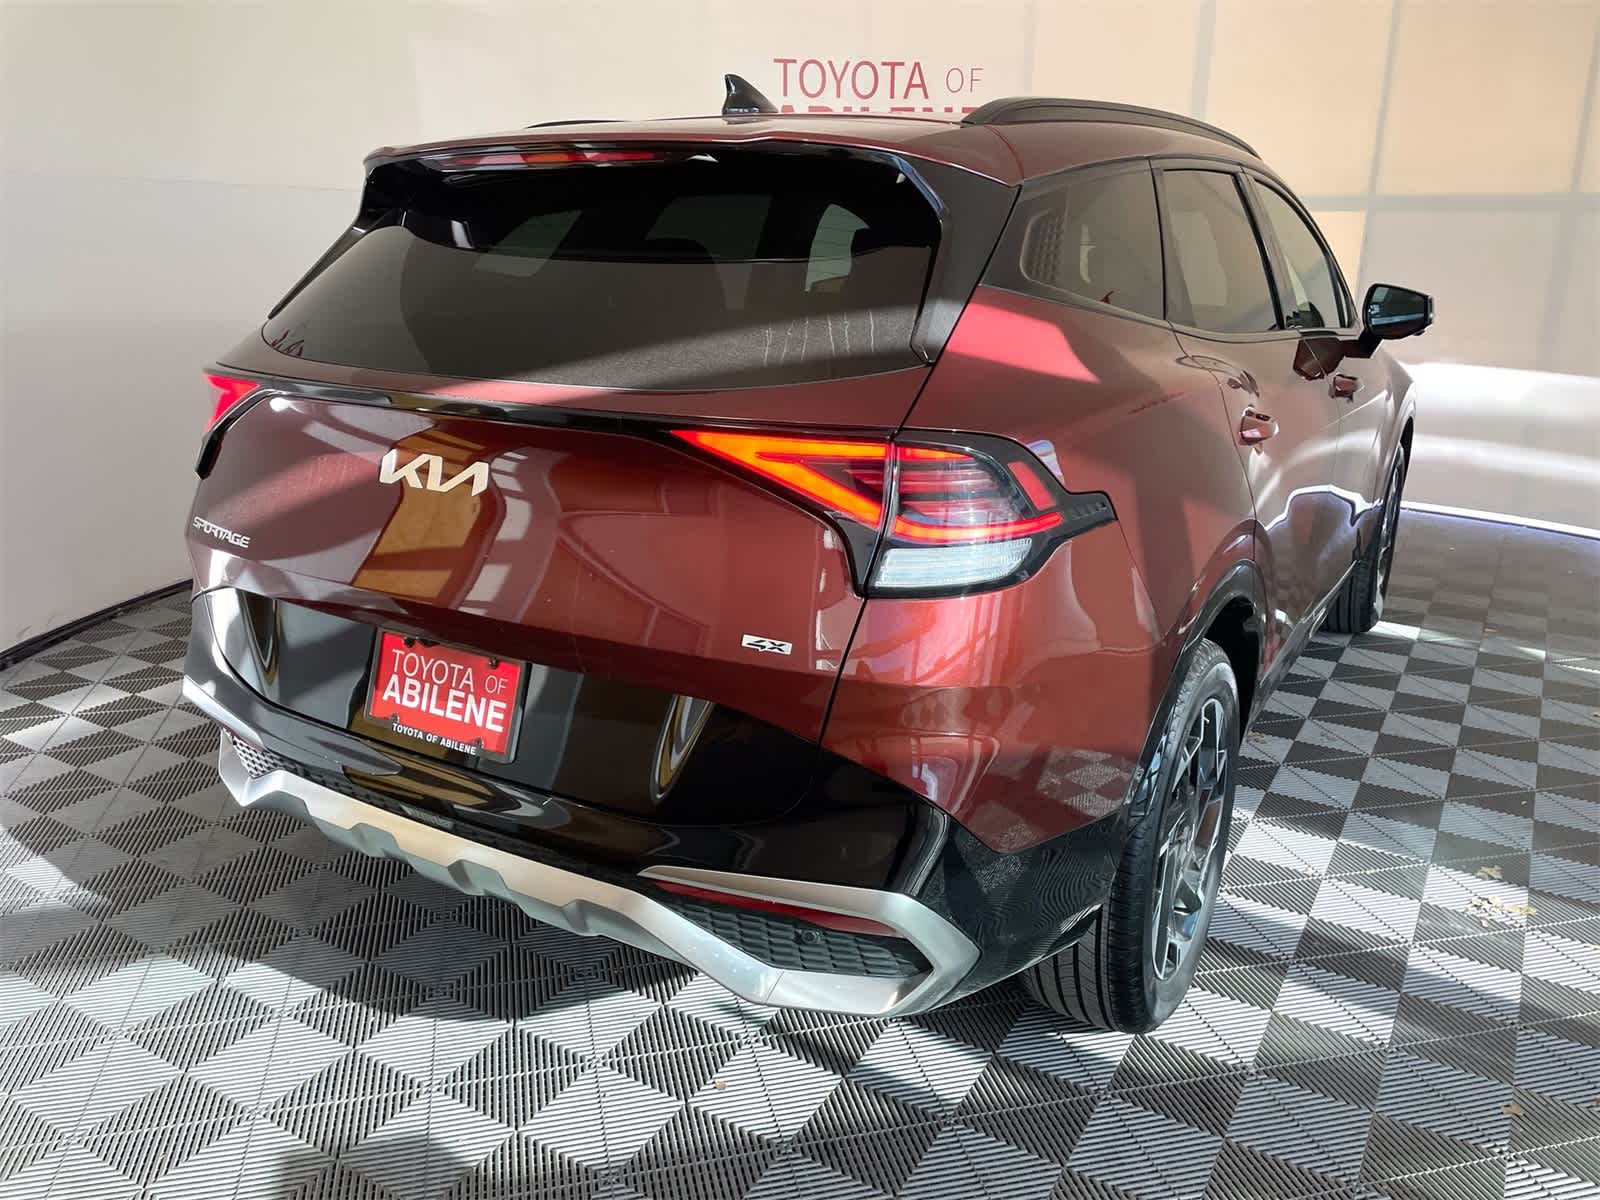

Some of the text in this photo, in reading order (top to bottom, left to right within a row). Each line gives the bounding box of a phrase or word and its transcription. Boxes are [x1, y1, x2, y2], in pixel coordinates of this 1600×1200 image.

[773, 58, 984, 100] TOYOTA OF
[193, 516, 251, 549] SPORTAGE
[392, 648, 509, 695] TOYOTA OF
[382, 673, 507, 733] ABILENE
[392, 723, 477, 756] TOYOTA OF ABILENE
